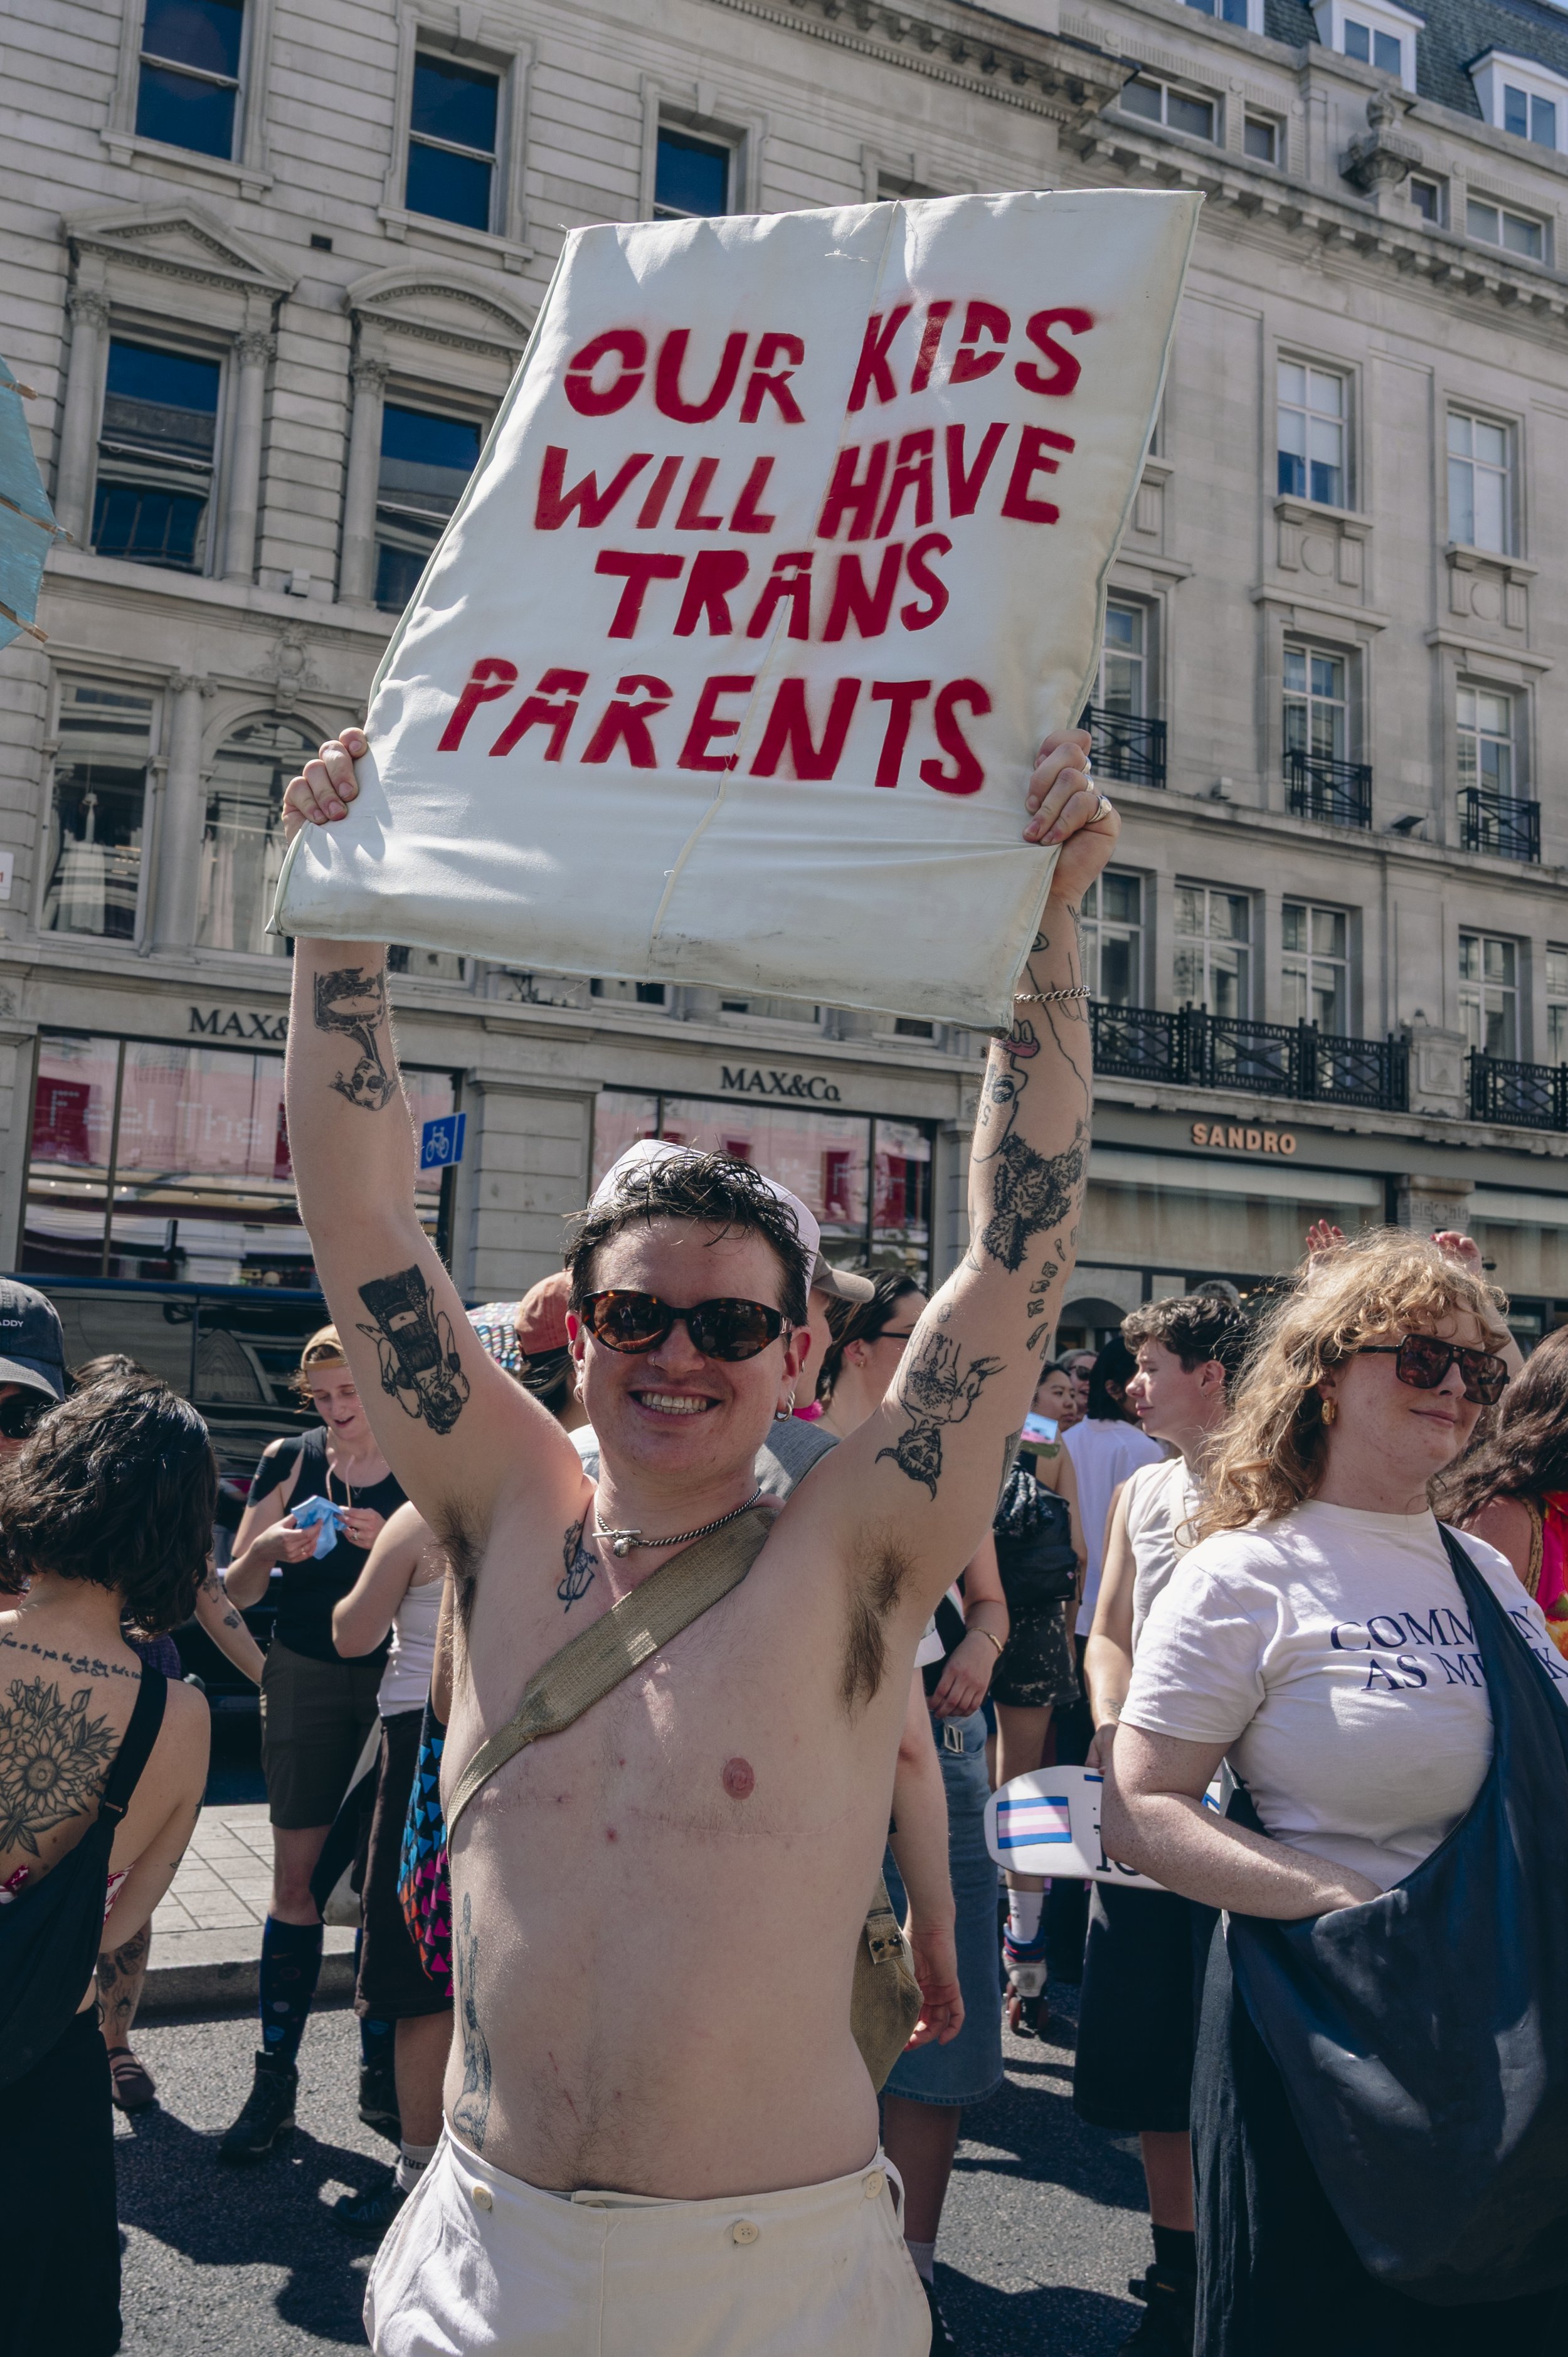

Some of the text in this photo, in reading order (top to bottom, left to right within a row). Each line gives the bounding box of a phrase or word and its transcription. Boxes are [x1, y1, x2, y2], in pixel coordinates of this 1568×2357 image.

[564, 300, 1093, 424] OUR KIDS
[534, 422, 1075, 541] WILL HAVE
[595, 533, 951, 642] TRANS
[438, 659, 990, 795] PARENTS
[1192, 1123, 1296, 1155] SANDRO
[1330, 1606, 1543, 1651] COMMN
[1360, 1654, 1428, 1691] AS
